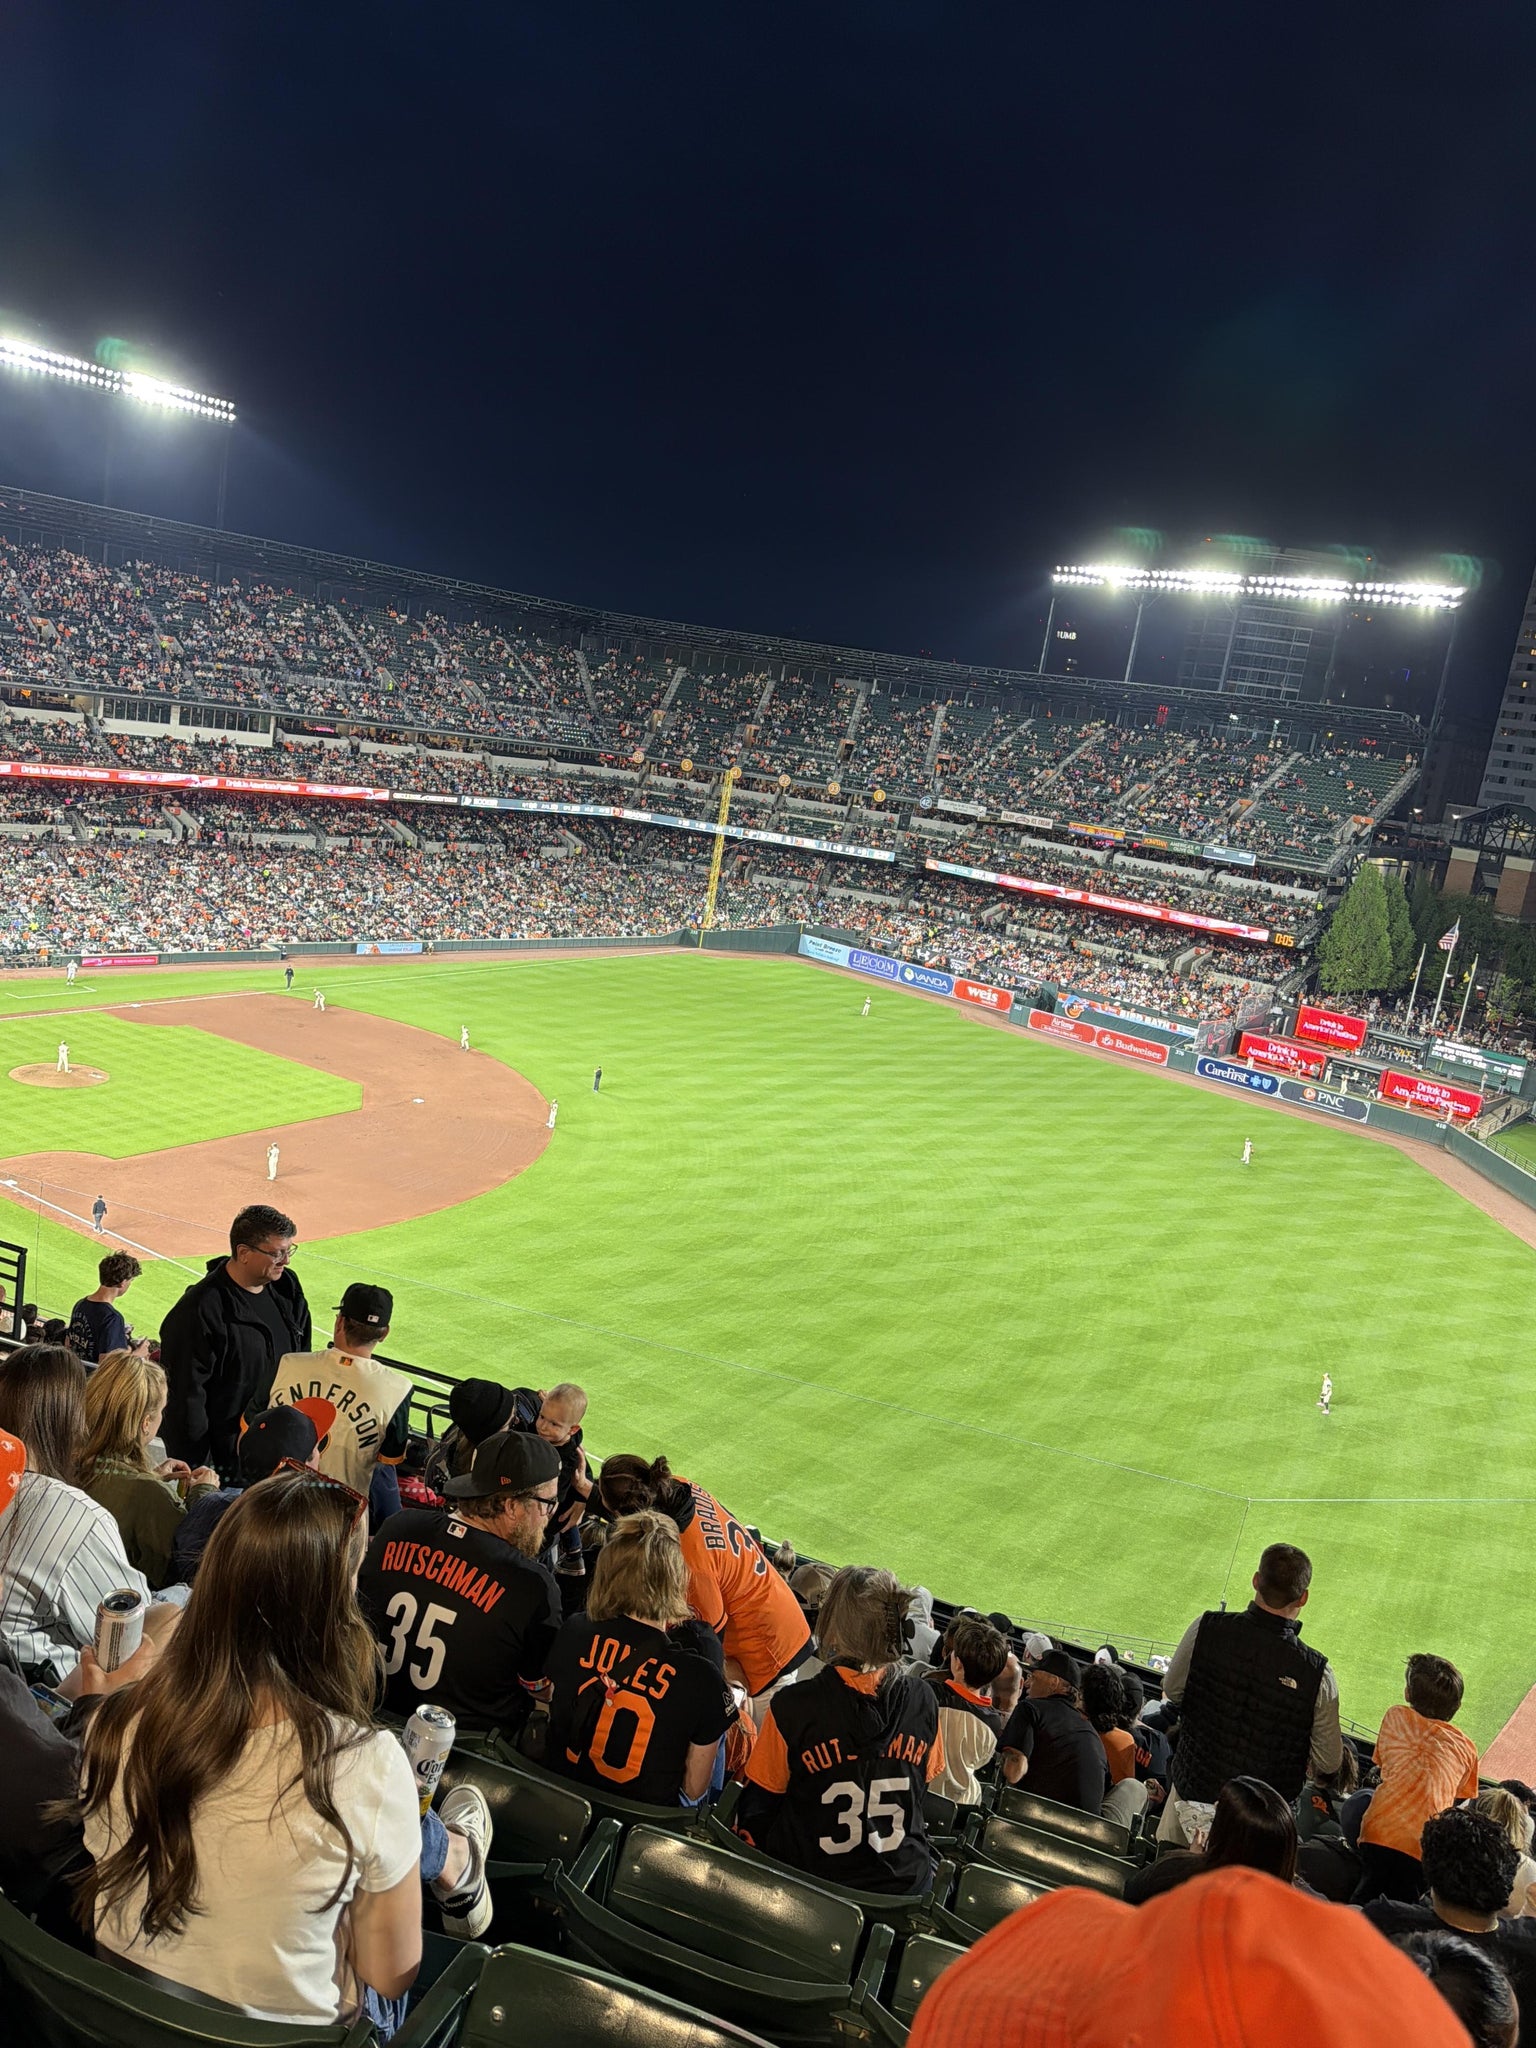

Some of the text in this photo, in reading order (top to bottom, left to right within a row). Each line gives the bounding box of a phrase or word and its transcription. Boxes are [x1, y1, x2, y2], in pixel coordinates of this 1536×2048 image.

[920, 798, 930, 808] 42
[1003, 812, 1015, 821] ENJOY
[1274, 933, 1295, 947] 0:05
[852, 953, 895, 974] LECOM
[914, 972, 949, 989] VANDA
[967, 985, 999, 1003] weis
[1145, 1016, 1170, 1029] BATH
[1320, 1018, 1336, 1029] Drink
[1114, 1038, 1162, 1060] Budweiser
[1268, 1042, 1298, 1058] Drink in
[1204, 1062, 1250, 1085] CareFirst
[1317, 1090, 1345, 1108] PNC
[1416, 1081, 1451, 1099] Drink in
[270, 1380, 379, 1450] ENDERSON
[381, 1541, 506, 1615] RUTSCHMAN
[378, 1591, 458, 1691] 35
[801, 1732, 928, 1774] RUTMAN
[819, 1776, 910, 1855] 35
